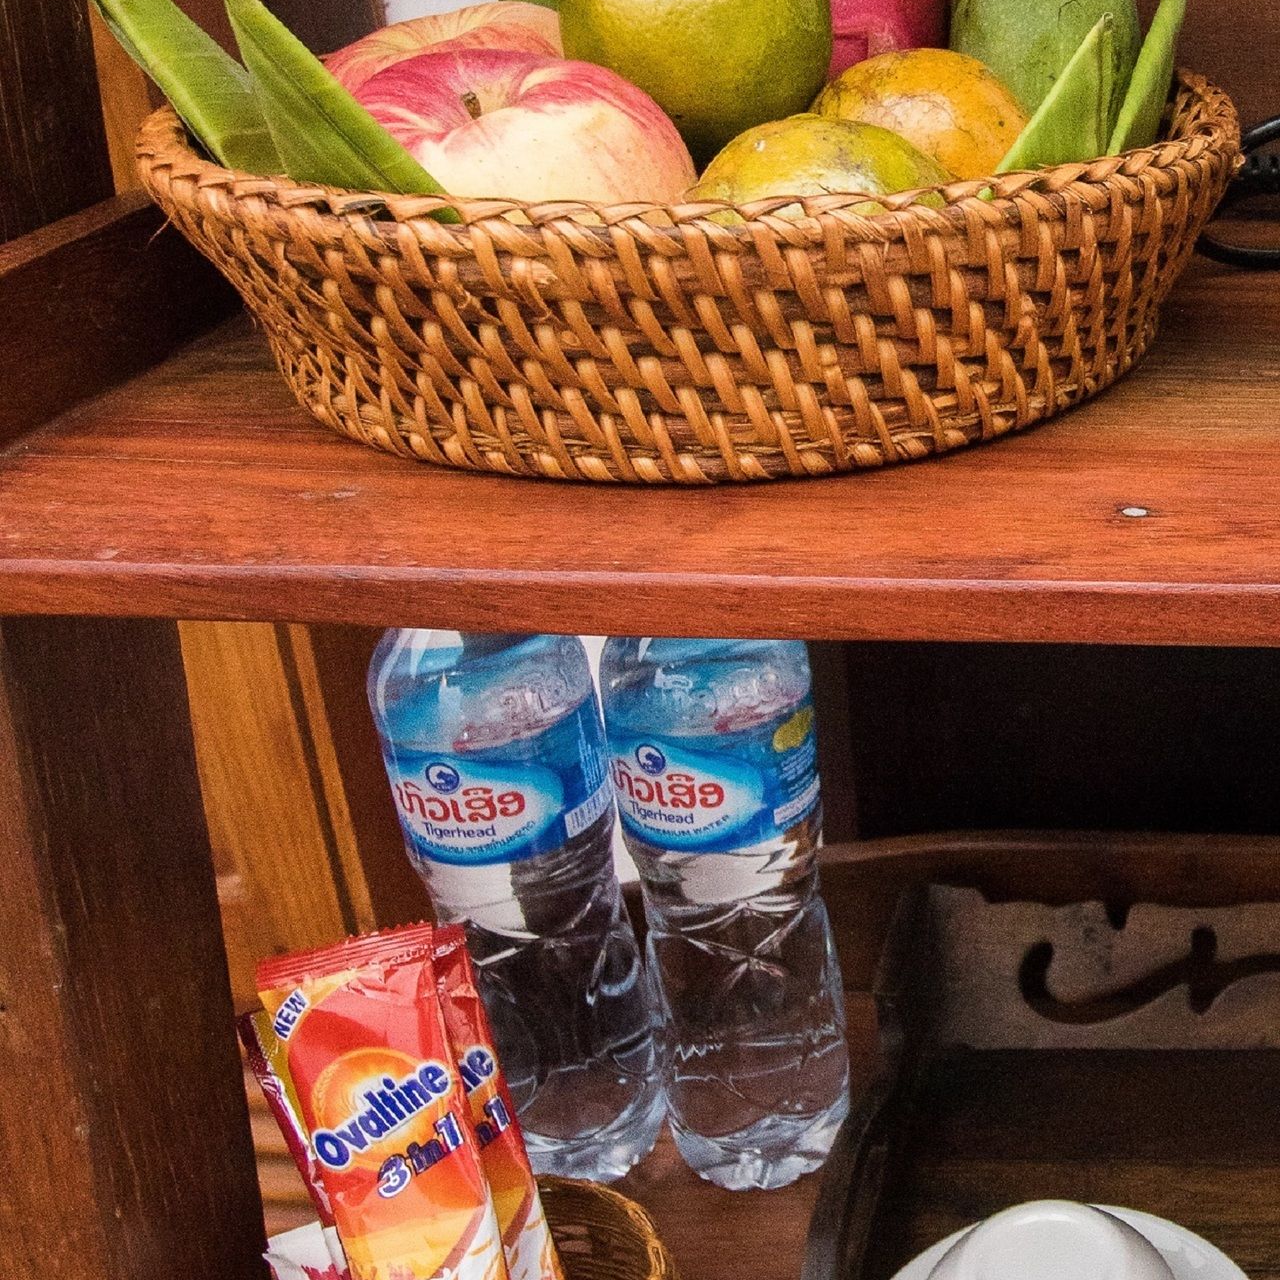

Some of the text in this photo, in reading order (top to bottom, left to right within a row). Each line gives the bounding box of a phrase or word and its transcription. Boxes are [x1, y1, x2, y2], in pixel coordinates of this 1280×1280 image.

[423, 821, 497, 839] Tigerhead
[629, 800, 695, 825] Tigerhead
[643, 814, 729, 837] PREMIUM WATER
[274, 992, 306, 1039] NEW
[313, 1063, 450, 1168] Ovaltine
[377, 1112, 463, 1198] 3 in 1
